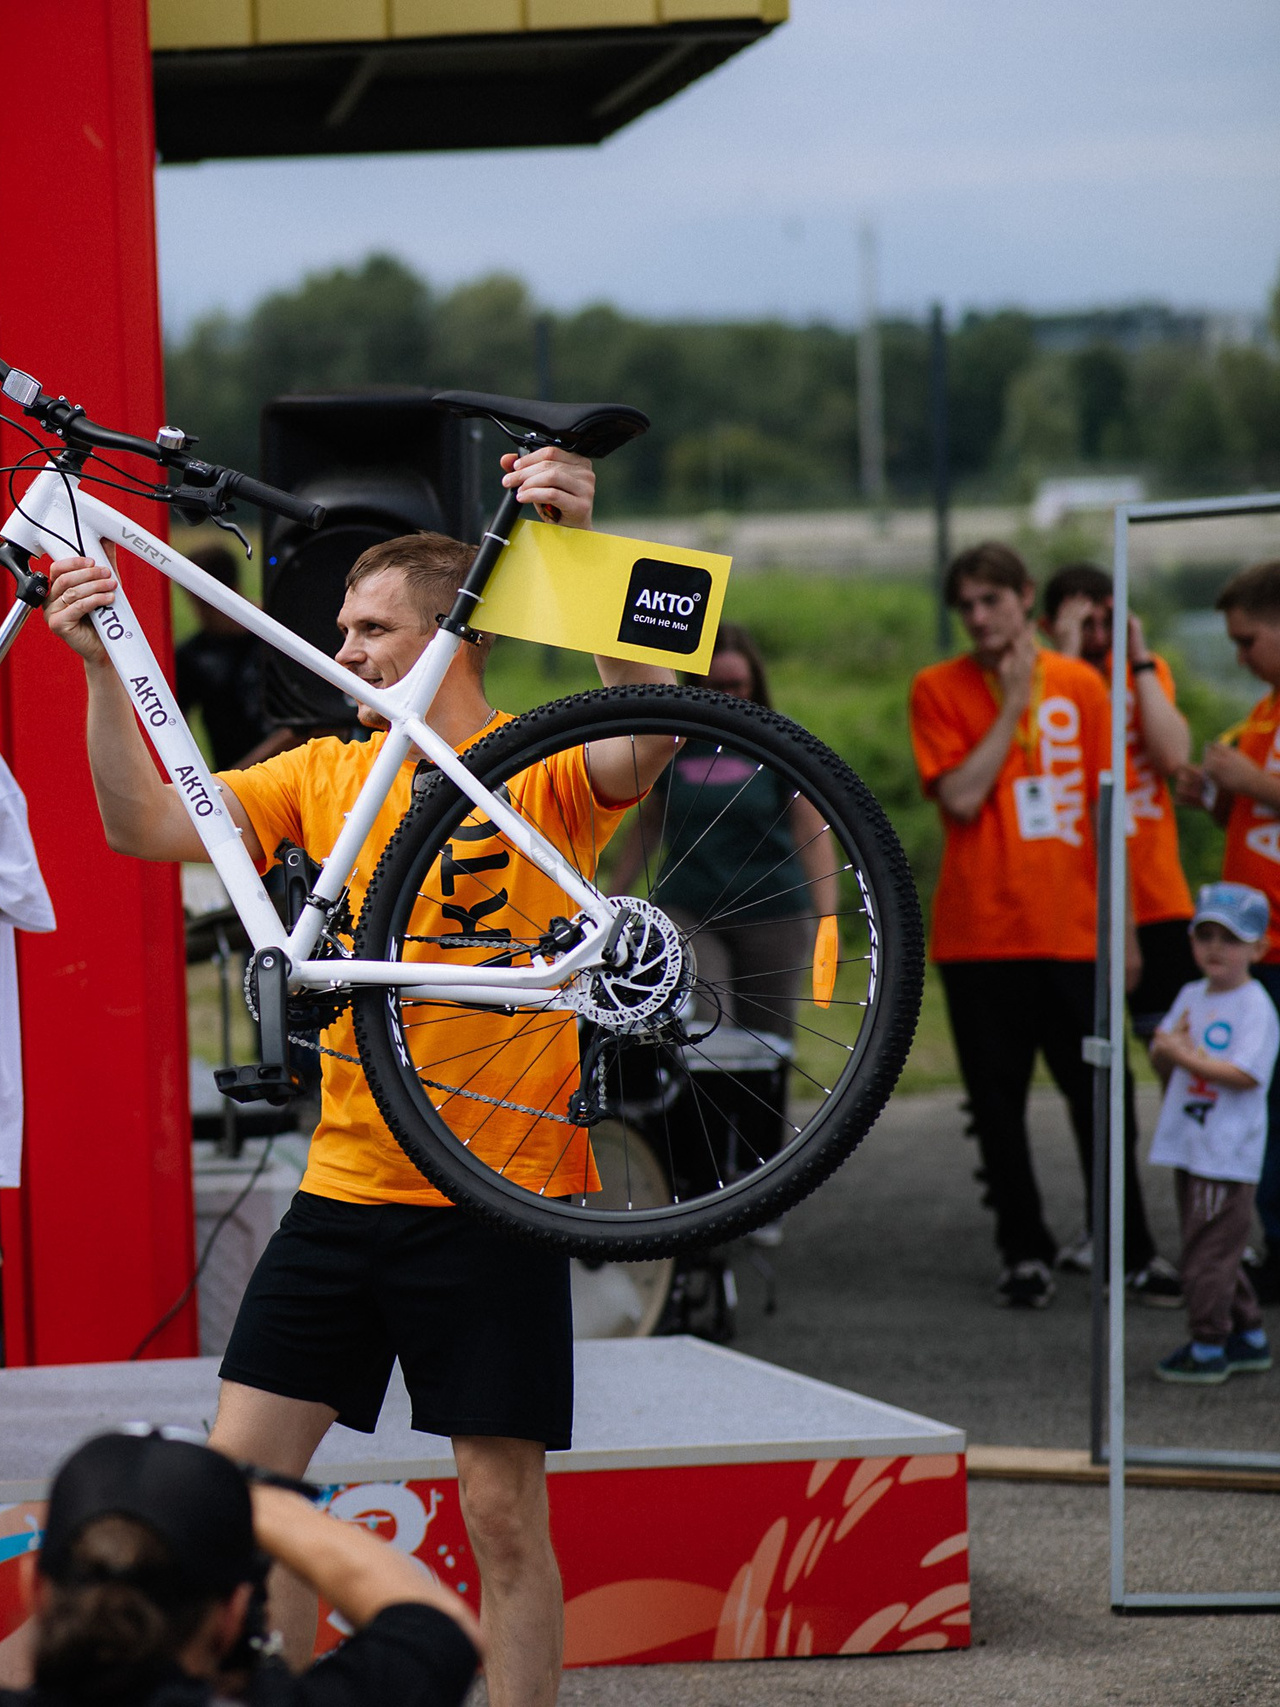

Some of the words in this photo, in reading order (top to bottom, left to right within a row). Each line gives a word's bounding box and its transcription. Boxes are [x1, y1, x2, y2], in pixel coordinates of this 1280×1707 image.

[120, 526, 171, 566] VERT
[636, 589, 694, 616] АКТО
[94, 604, 124, 640] КТО
[634, 614, 656, 625] если
[658, 618, 670, 628] не
[672, 621, 688, 631] мы
[130, 676, 168, 727] АКТО
[175, 765, 214, 817] АКТО
